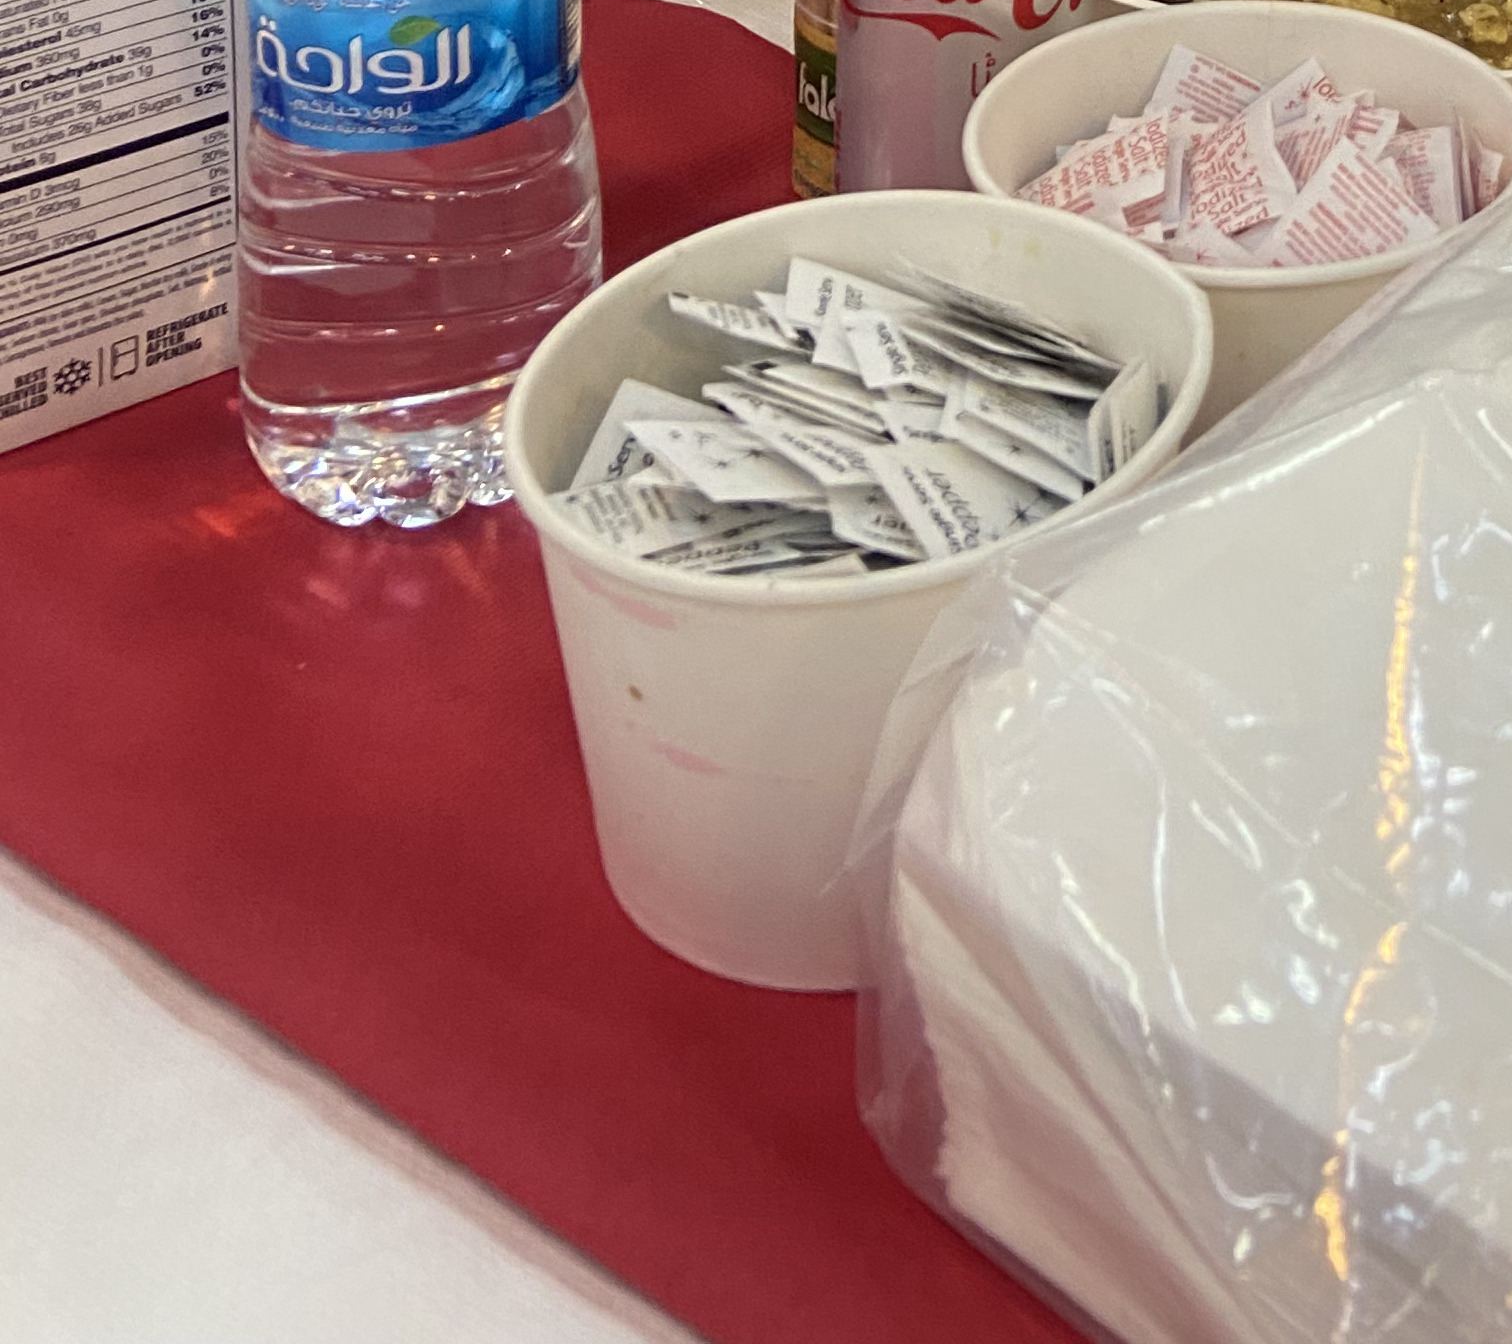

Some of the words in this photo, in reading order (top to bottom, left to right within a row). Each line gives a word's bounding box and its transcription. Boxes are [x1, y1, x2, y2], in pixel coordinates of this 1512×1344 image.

[65, 21, 102, 38] 45mg
[20, 53, 125, 92] Carbohydrate
[193, 23, 225, 42] 14%
[256, 14, 471, 95] الواحة
[43, 87, 76, 104] Fiber
[202, 43, 226, 59] 0%
[29, 108, 75, 129] Sugars
[202, 62, 226, 76] 0%
[11, 129, 66, 154] Includes
[138, 93, 183, 115] Sugars
[194, 80, 226, 98] 52%
[1128, 135, 1149, 167] Salt
[1074, 160, 1092, 190] Salt
[30, 187, 42, 201] D
[146, 301, 229, 343] REFRIGERATE
[146, 330, 186, 356] AFTER
[146, 337, 203, 368] OPENING
